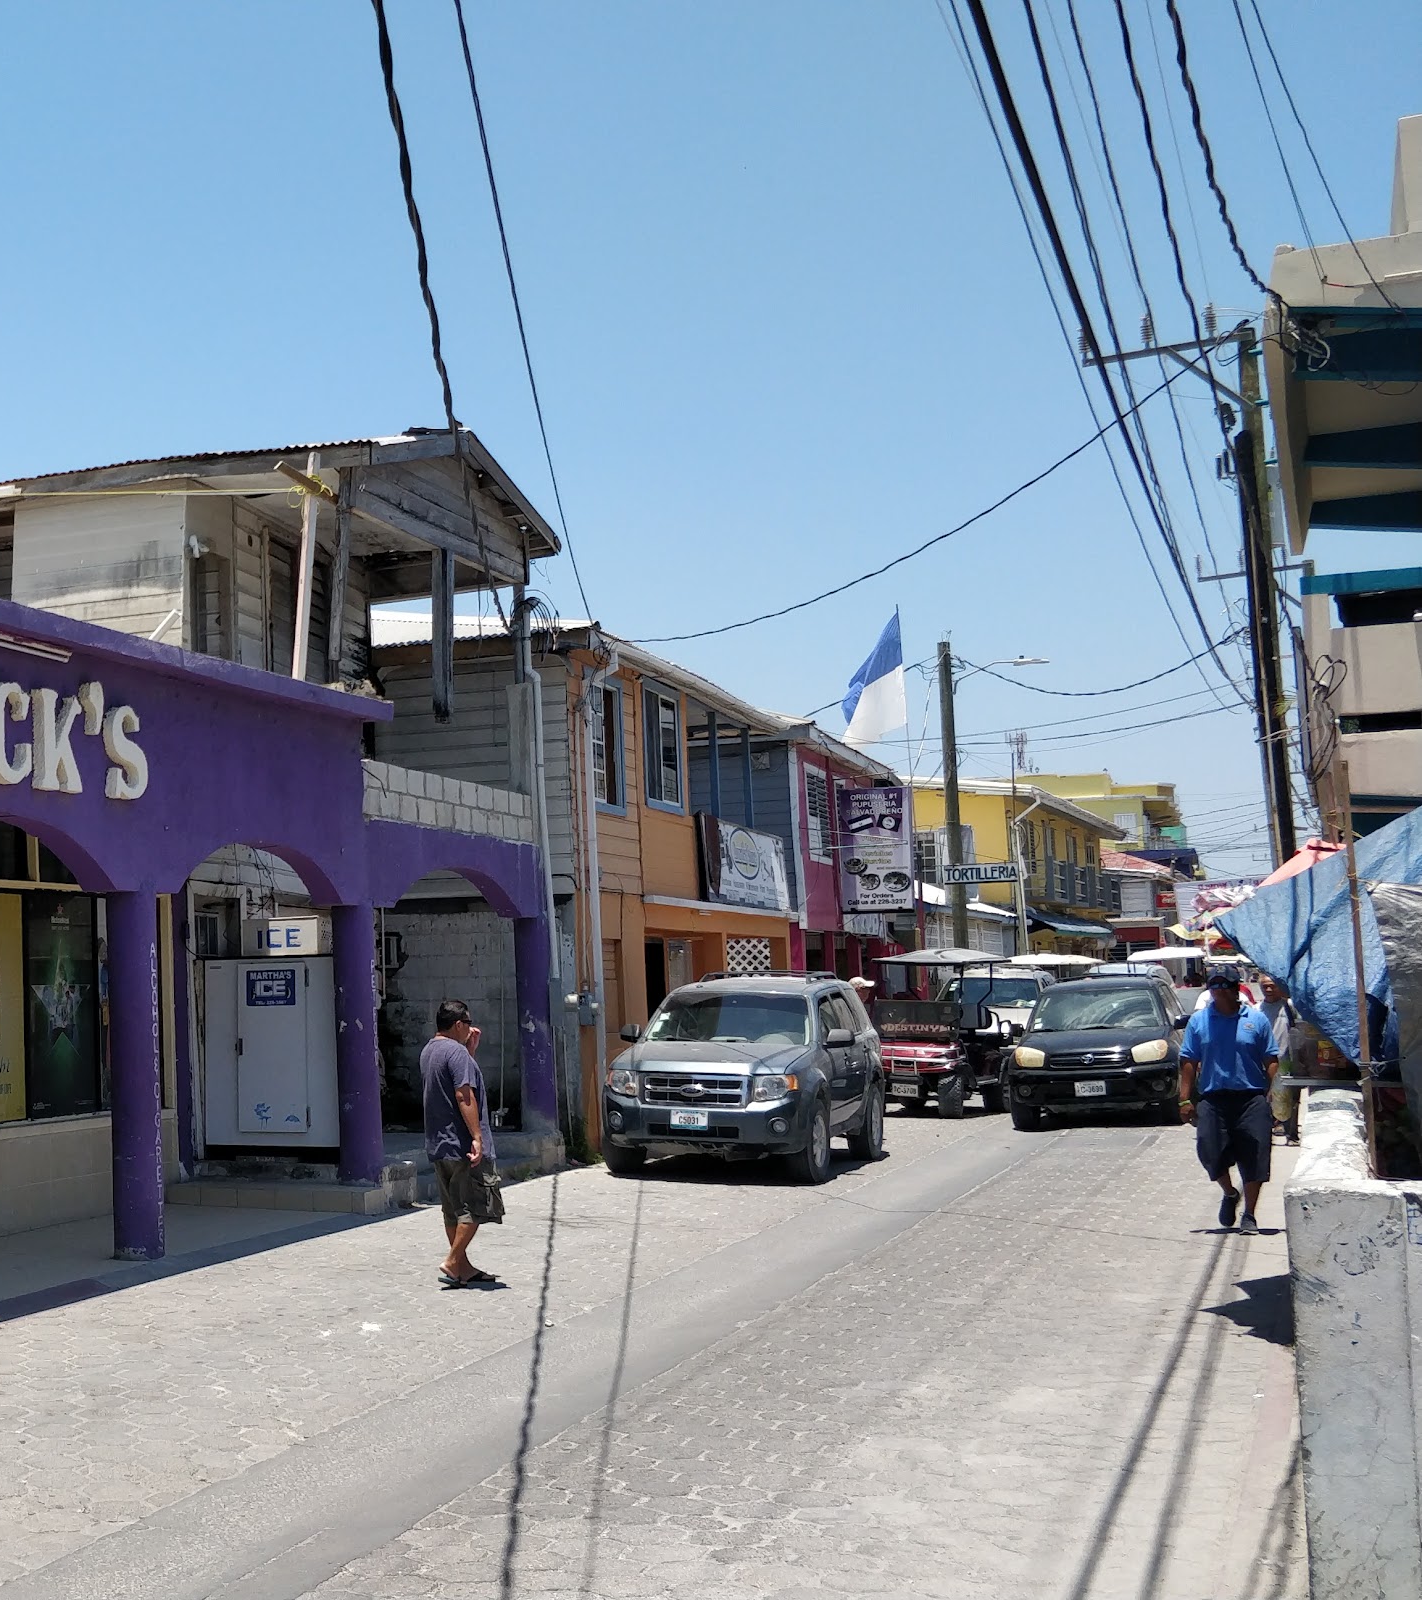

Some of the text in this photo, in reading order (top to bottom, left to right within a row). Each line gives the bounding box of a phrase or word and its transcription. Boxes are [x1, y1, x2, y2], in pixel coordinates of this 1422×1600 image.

[850, 793, 887, 801] ORIGINAL
[944, 865, 1017, 881] TORTILLERIA
[257, 928, 301, 949] ICE
[250, 971, 292, 981] MARTHA'S
[255, 980, 286, 998] ICE
[678, 1116, 699, 1125] C5031
